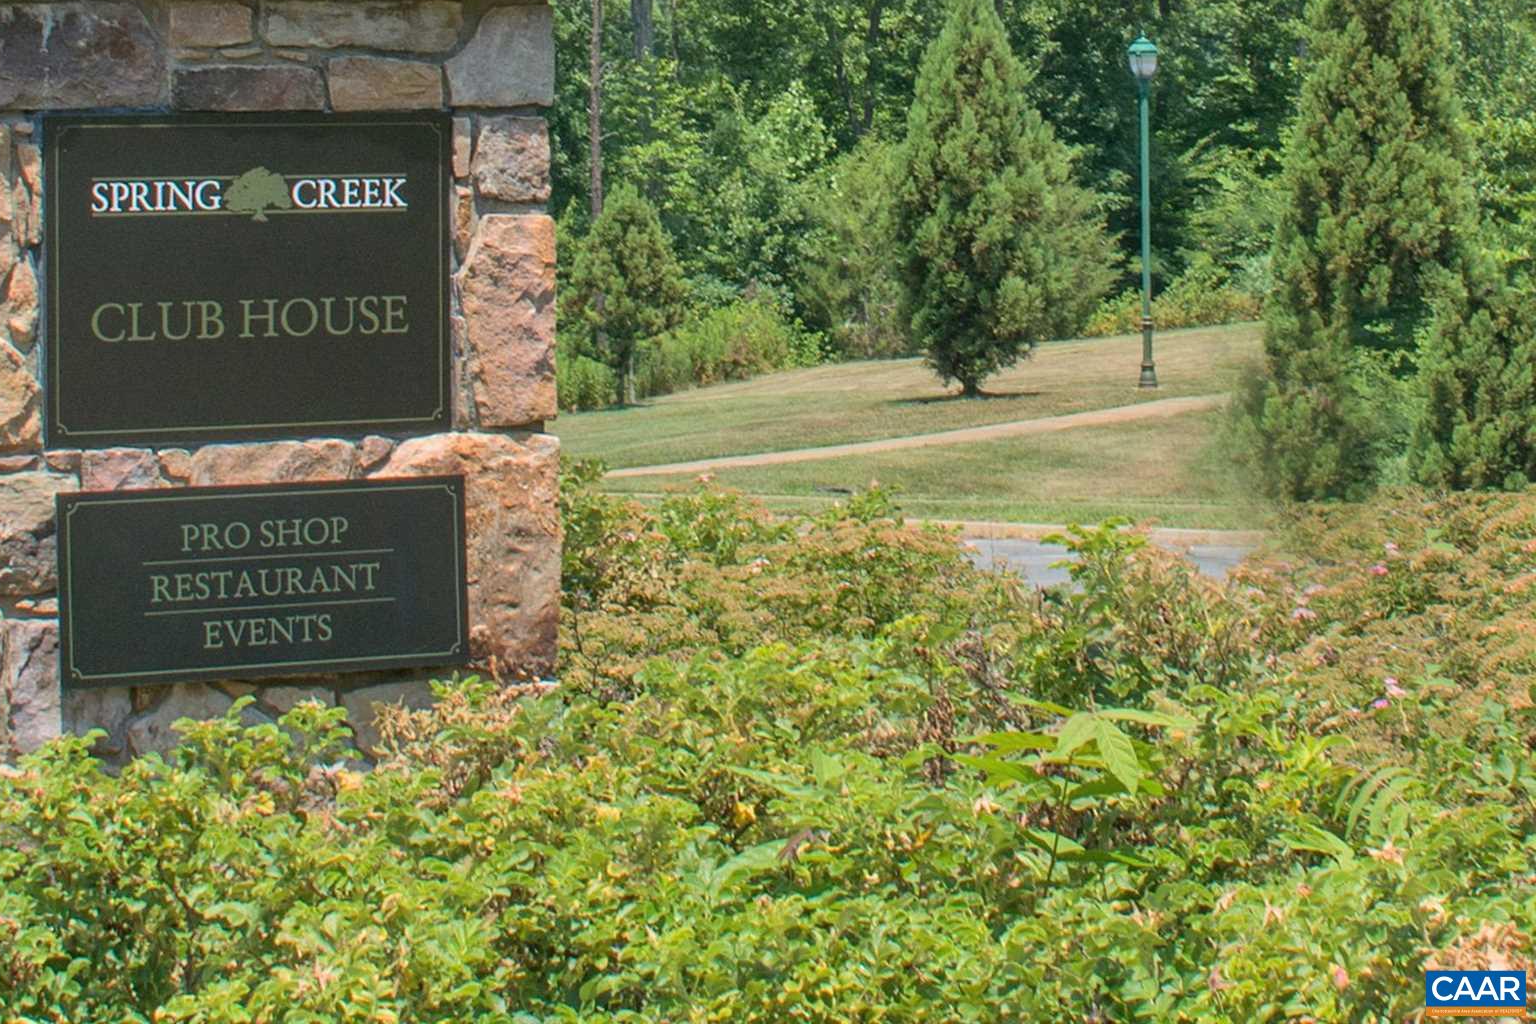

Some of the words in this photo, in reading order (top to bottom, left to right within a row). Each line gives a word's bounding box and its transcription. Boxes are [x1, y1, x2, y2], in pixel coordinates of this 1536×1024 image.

[91, 179, 223, 212] SPRING
[291, 178, 409, 209] CREEK
[90, 301, 225, 343] CLUB
[238, 295, 409, 338] HOUSE
[180, 521, 251, 552] PRO
[259, 516, 349, 548] SHOP
[149, 561, 381, 603] RESTAURANT
[202, 613, 333, 649] EVENTS
